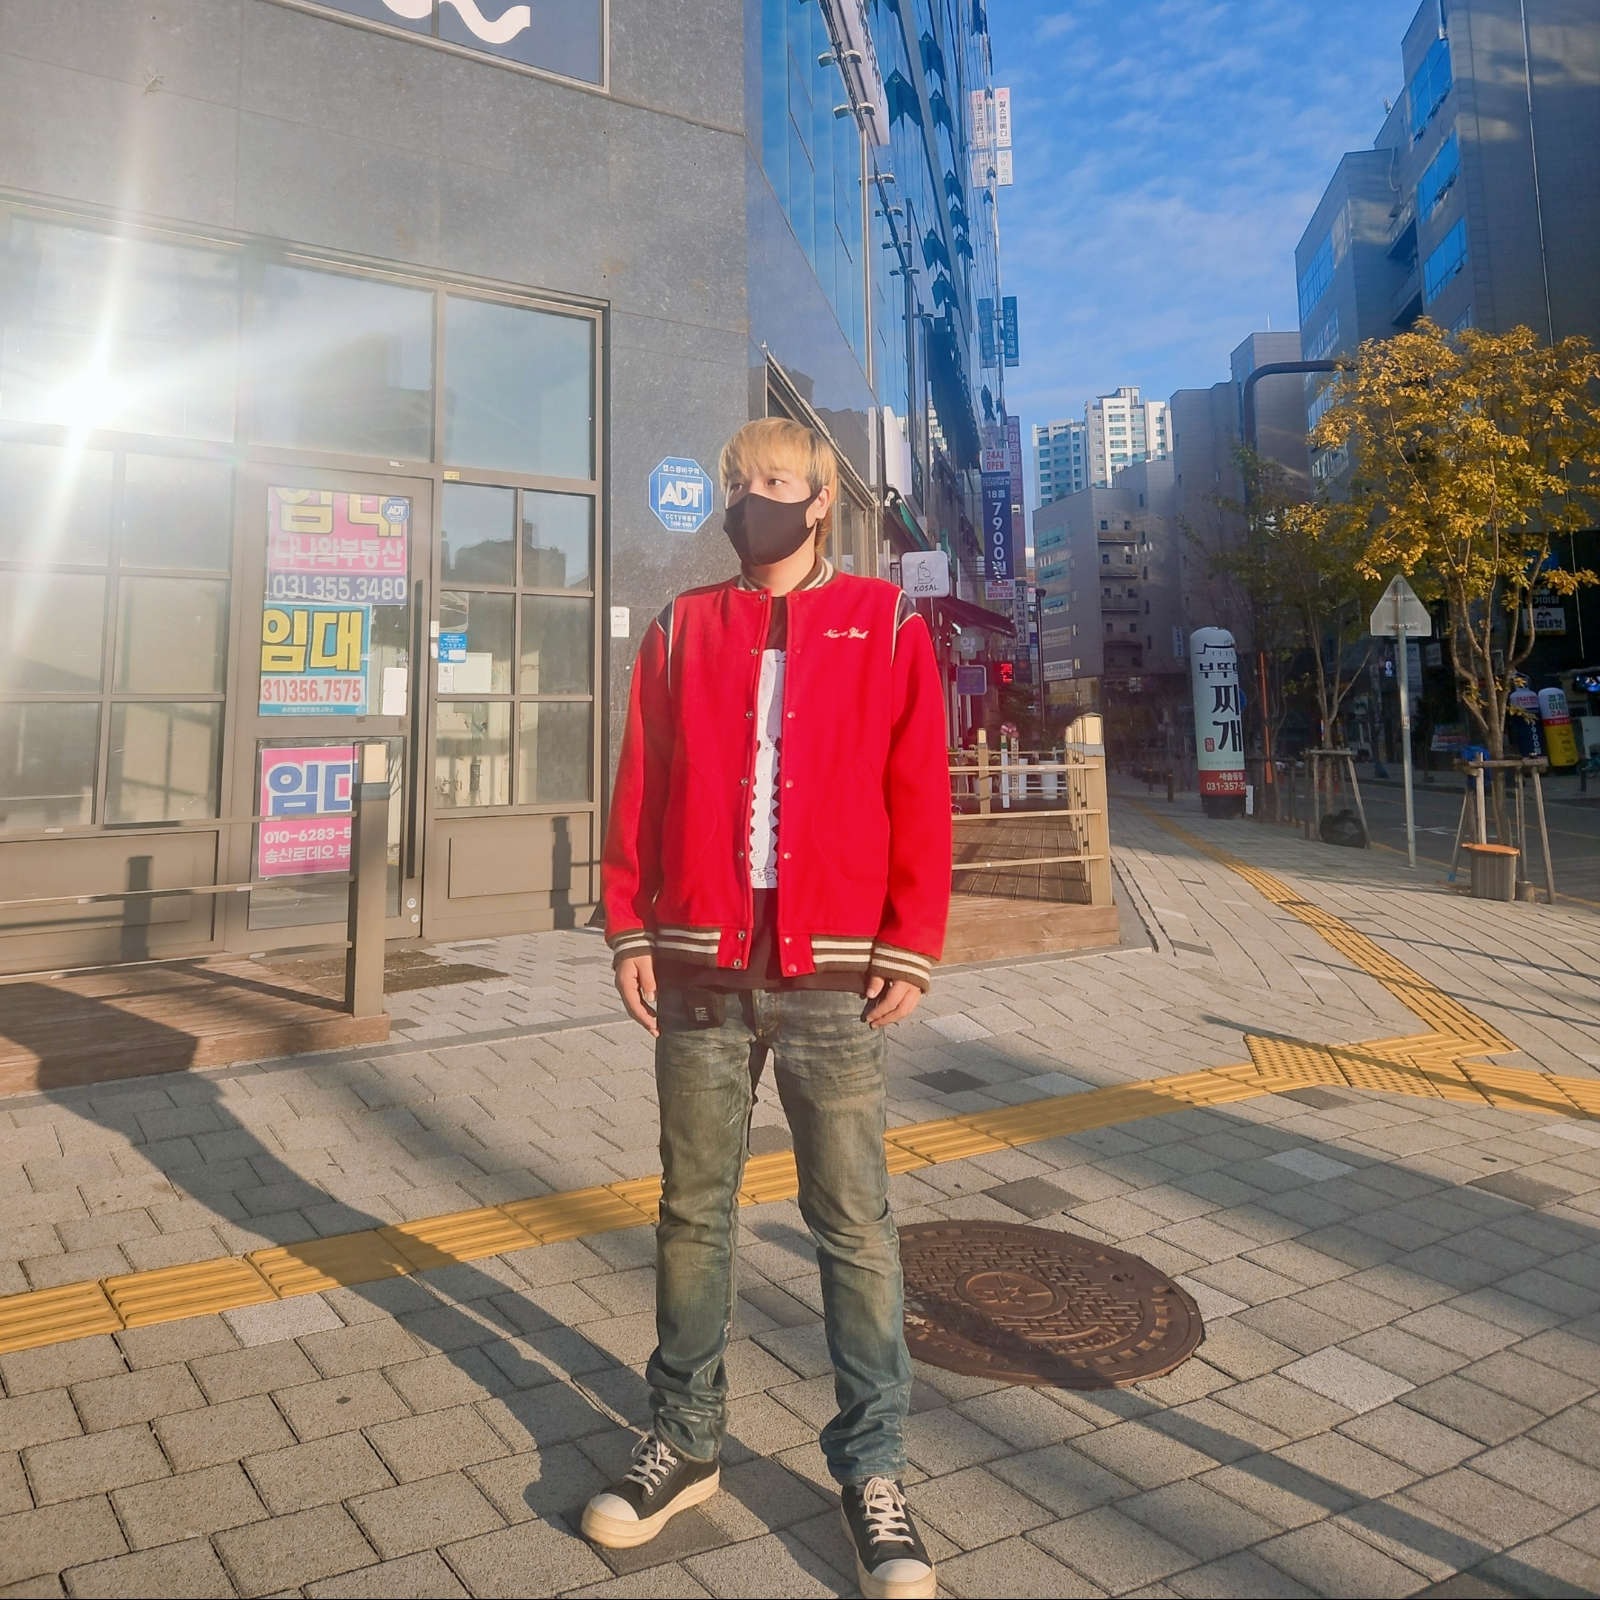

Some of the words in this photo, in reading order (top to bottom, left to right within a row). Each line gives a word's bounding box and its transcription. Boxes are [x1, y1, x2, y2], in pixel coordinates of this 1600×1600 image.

[986, 450, 1004, 460] 24시
[986, 461, 1005, 471] OPEN
[660, 480, 703, 508] ADT
[387, 505, 406, 516] ADT
[274, 535, 404, 568] 다나와부동산
[914, 584, 939, 593] KOSAL
[261, 609, 363, 672] 임대
[960, 636, 976, 653] 약
[265, 845, 334, 864] 송산로데오
